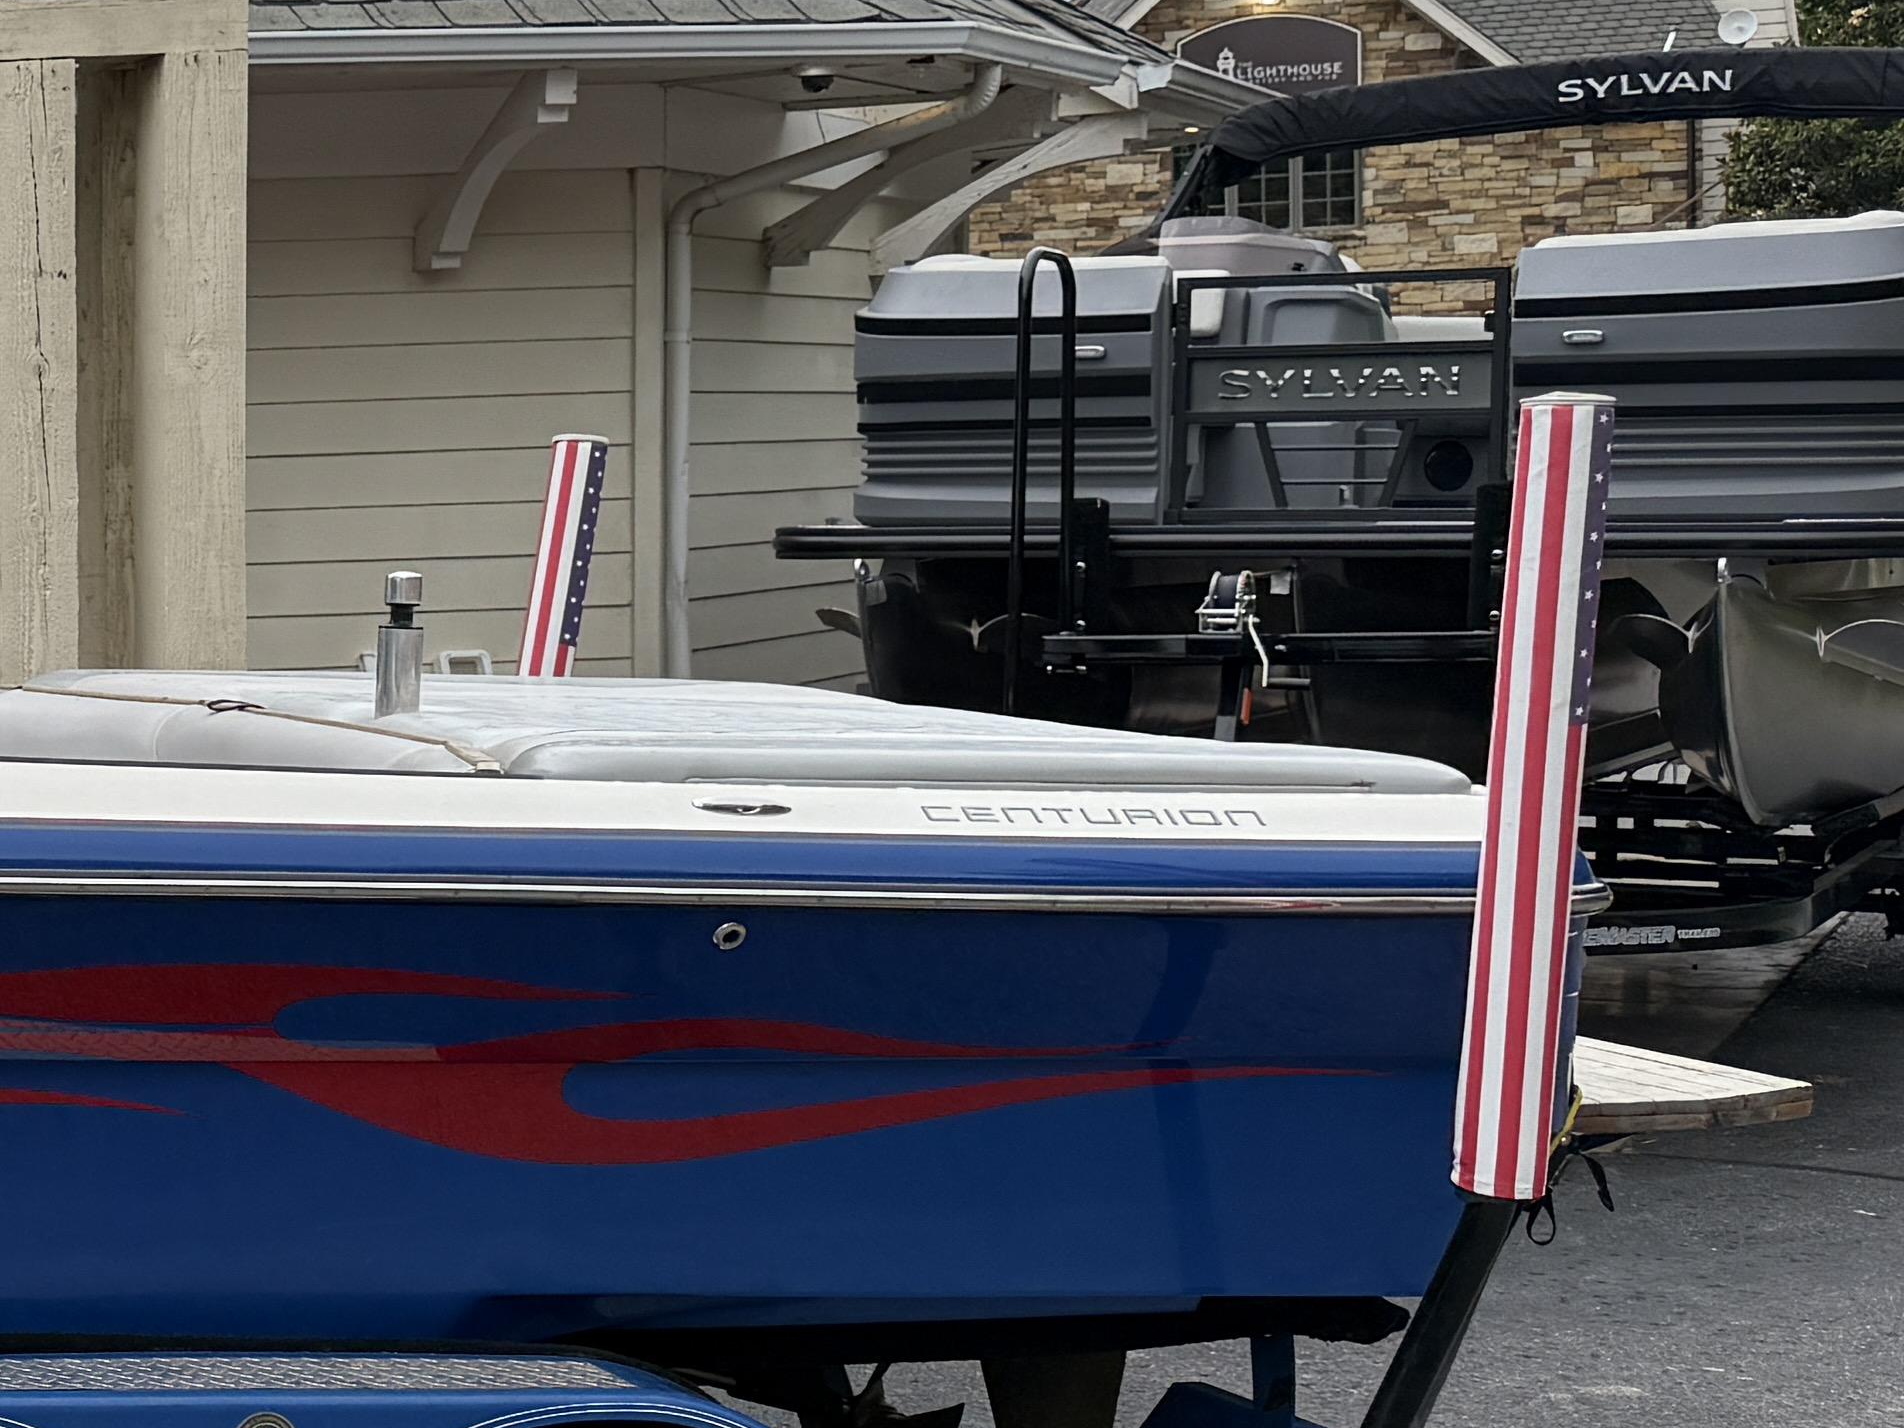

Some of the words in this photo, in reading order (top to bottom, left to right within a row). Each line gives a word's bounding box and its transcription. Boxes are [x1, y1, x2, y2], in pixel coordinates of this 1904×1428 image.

[1236, 61, 1343, 80] LIGHTHOUSE
[1557, 69, 1733, 103] SYLVAN
[1218, 365, 1460, 398] SYLVAN
[920, 805, 1267, 827] CENTURION
